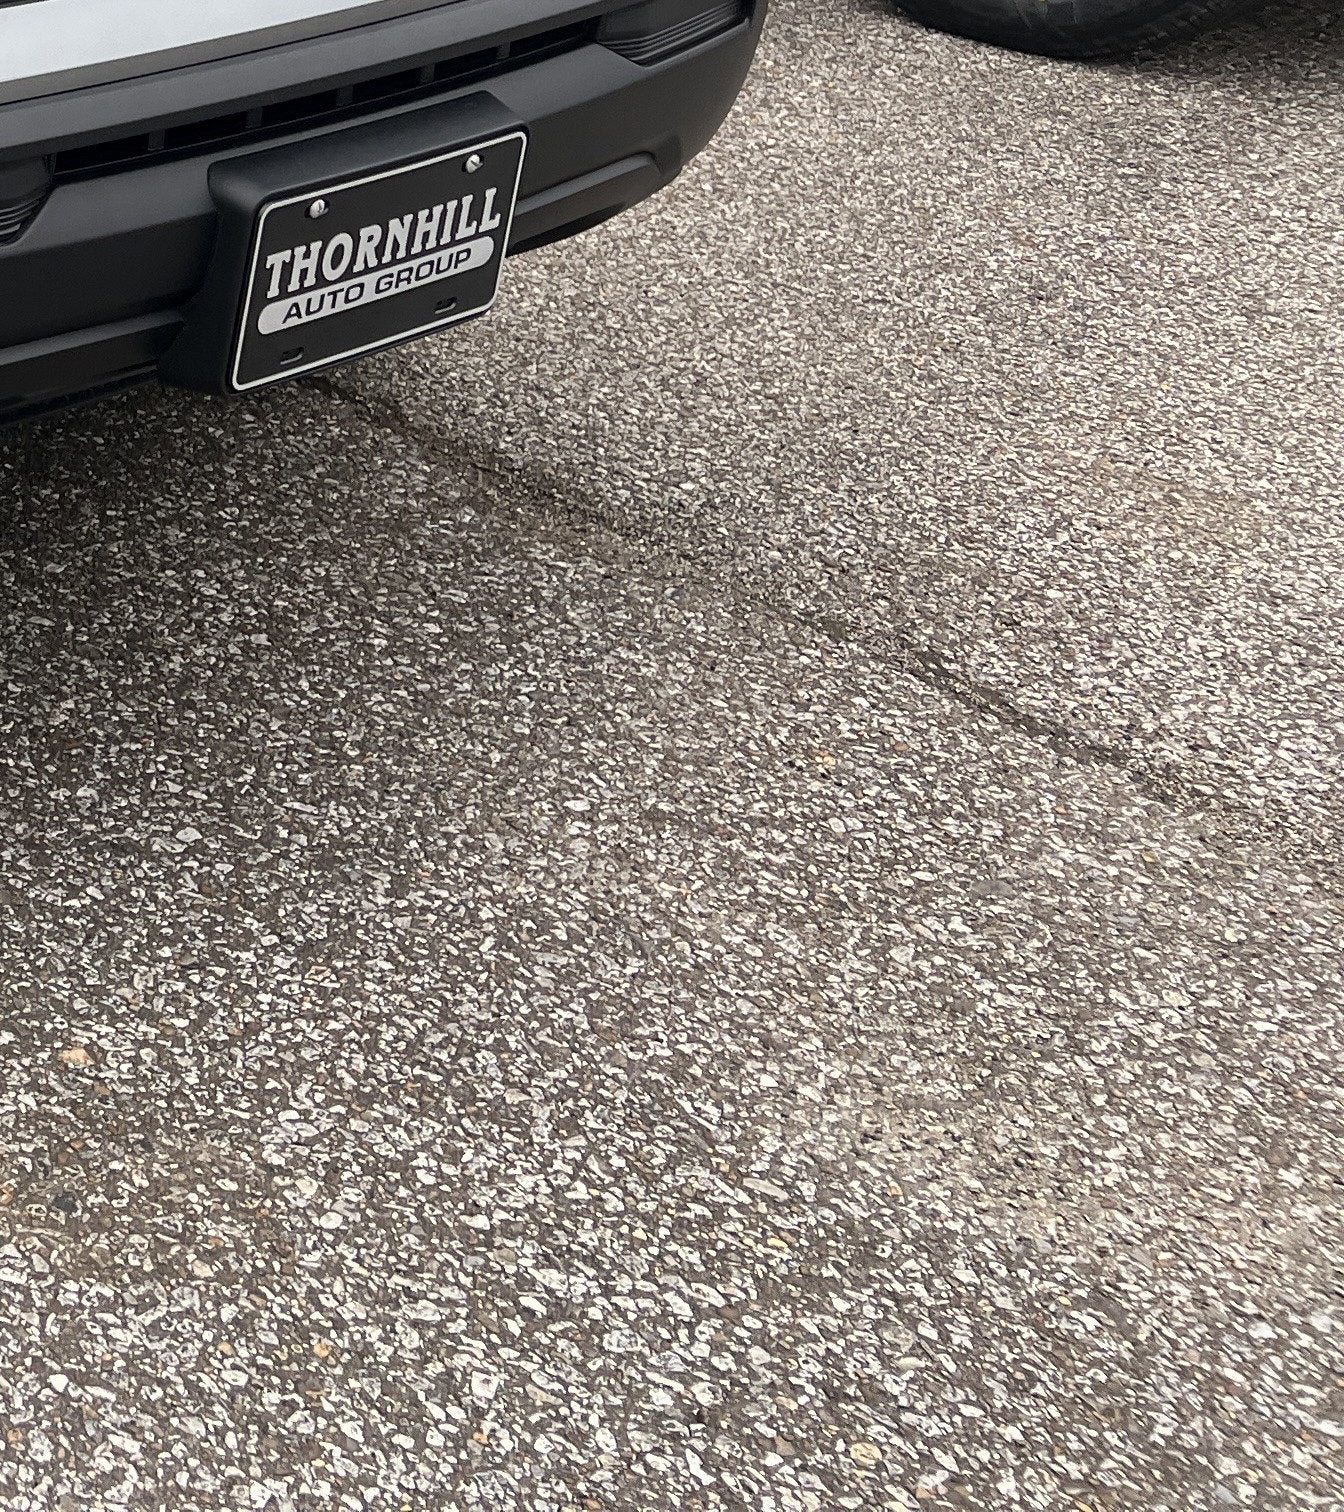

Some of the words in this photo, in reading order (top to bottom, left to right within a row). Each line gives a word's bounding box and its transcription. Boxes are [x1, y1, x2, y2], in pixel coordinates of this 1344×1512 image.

[265, 187, 502, 299] THORNHILL
[281, 282, 365, 325] AUTO
[374, 247, 472, 298] GROUP
